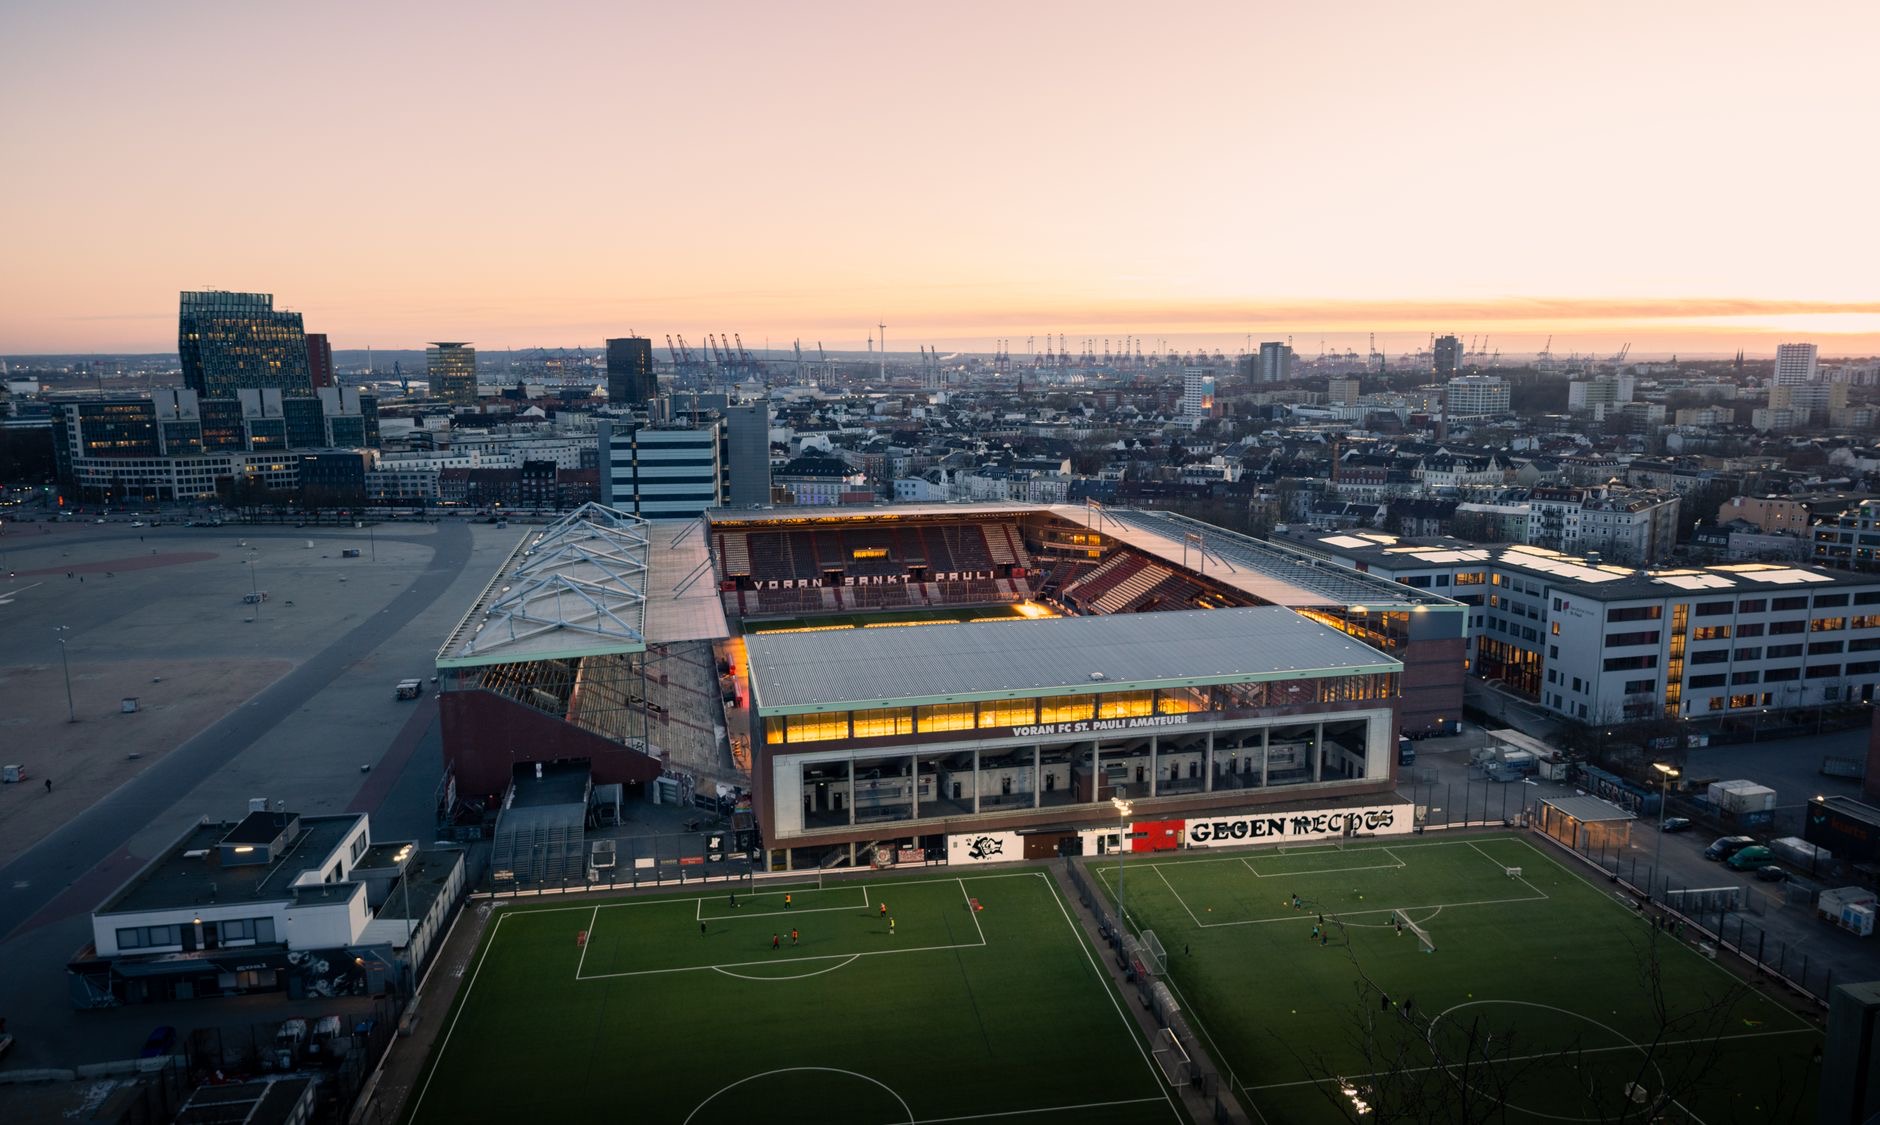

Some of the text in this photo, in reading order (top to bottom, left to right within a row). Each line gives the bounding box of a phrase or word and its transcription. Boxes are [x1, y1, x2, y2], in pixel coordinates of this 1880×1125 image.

[754, 571, 994, 590] VORAN SANKT PAULI
[1013, 715, 1188, 737] VORAN FC ST. PAULI AMATEURE
[1190, 809, 1394, 842] GEGEN RECHTS
